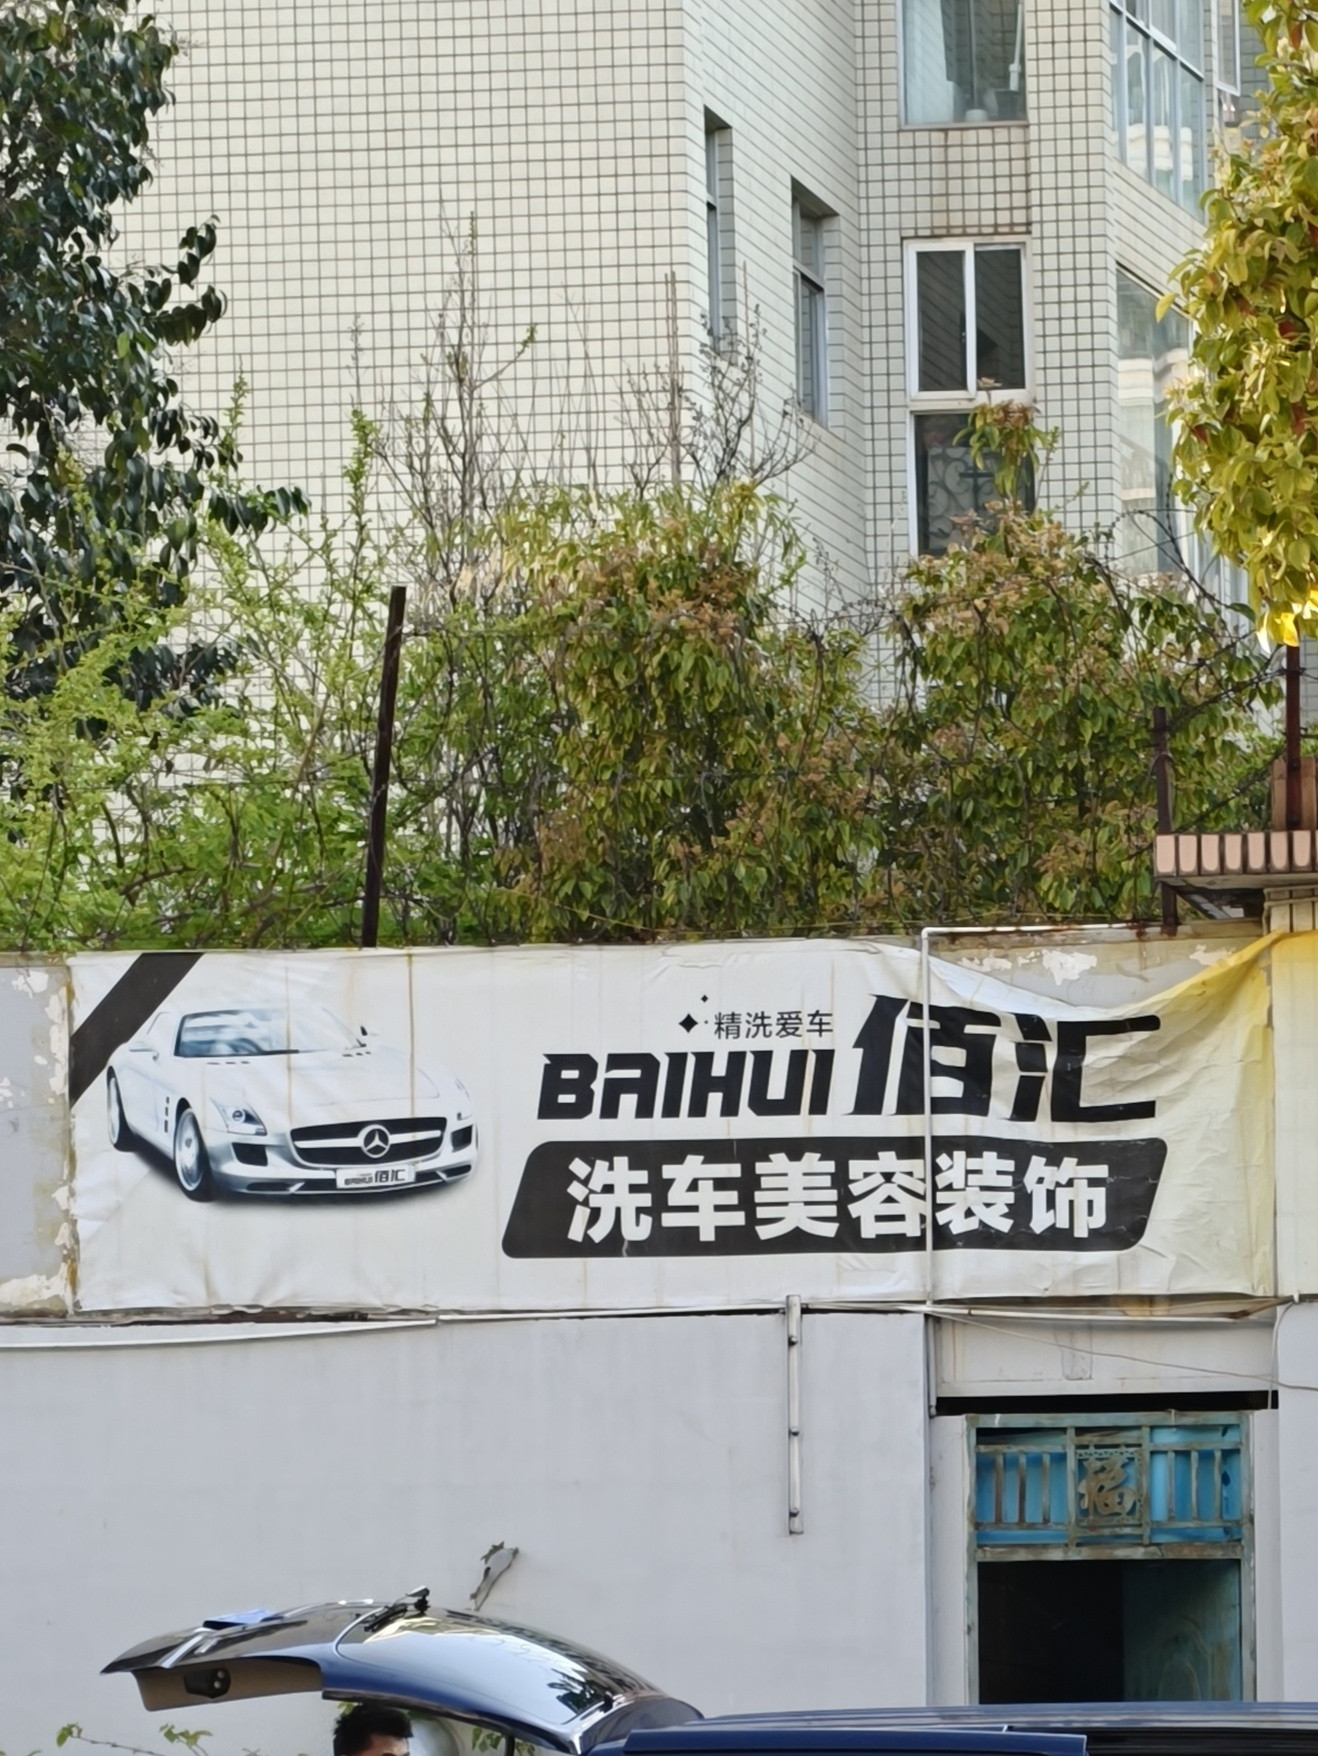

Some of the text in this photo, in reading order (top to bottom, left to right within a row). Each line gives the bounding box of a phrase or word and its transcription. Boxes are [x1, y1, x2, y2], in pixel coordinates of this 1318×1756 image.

[537, 994, 1161, 1122] BAIHUI 佰汇
[713, 1009, 834, 1040] 精洗爱车
[567, 1152, 1109, 1244] 洗车美容装饰
